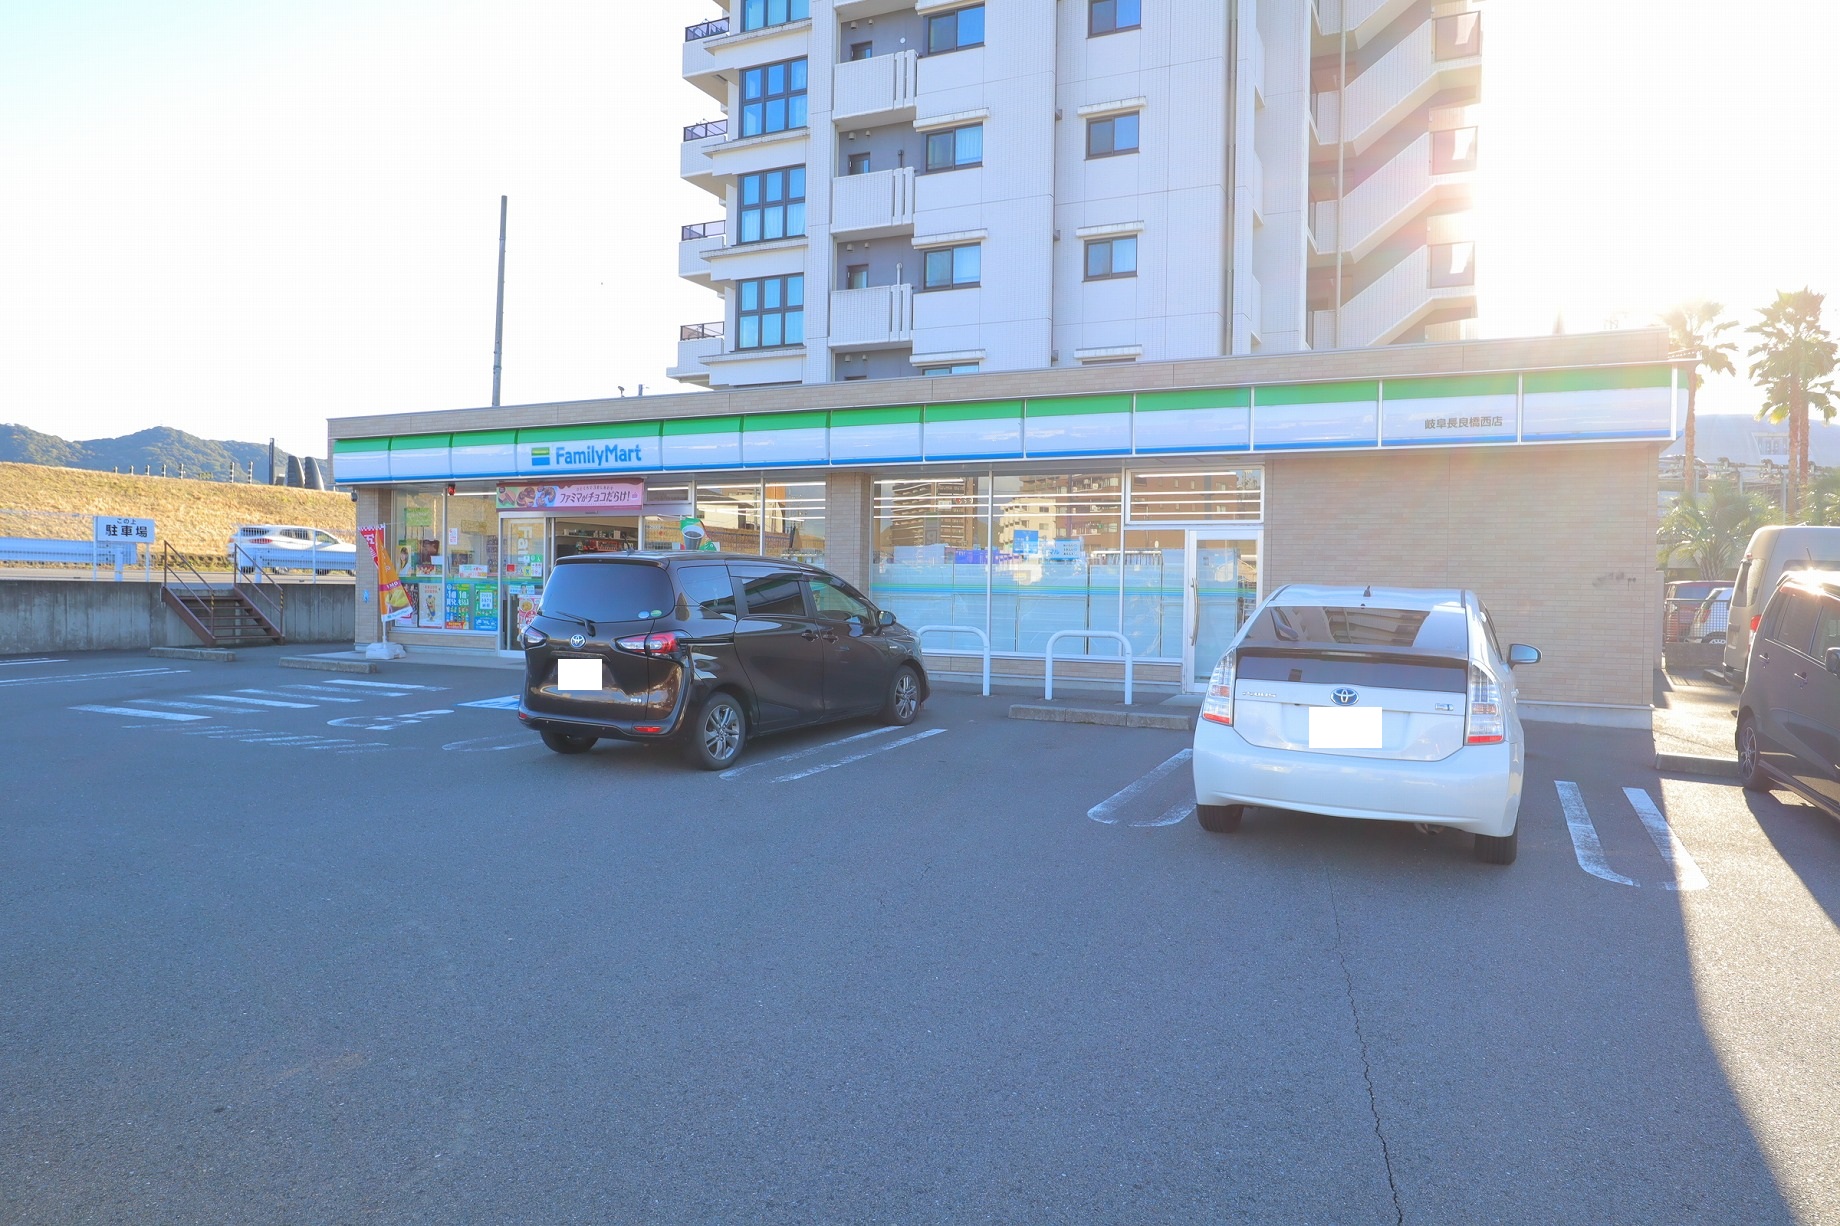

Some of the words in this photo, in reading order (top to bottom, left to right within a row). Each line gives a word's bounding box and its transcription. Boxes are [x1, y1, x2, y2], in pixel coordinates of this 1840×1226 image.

[1424, 415, 1503, 430] 岐阜長良橋西店
[555, 443, 642, 466] FamilyMart
[105, 524, 148, 538] 駐車場
